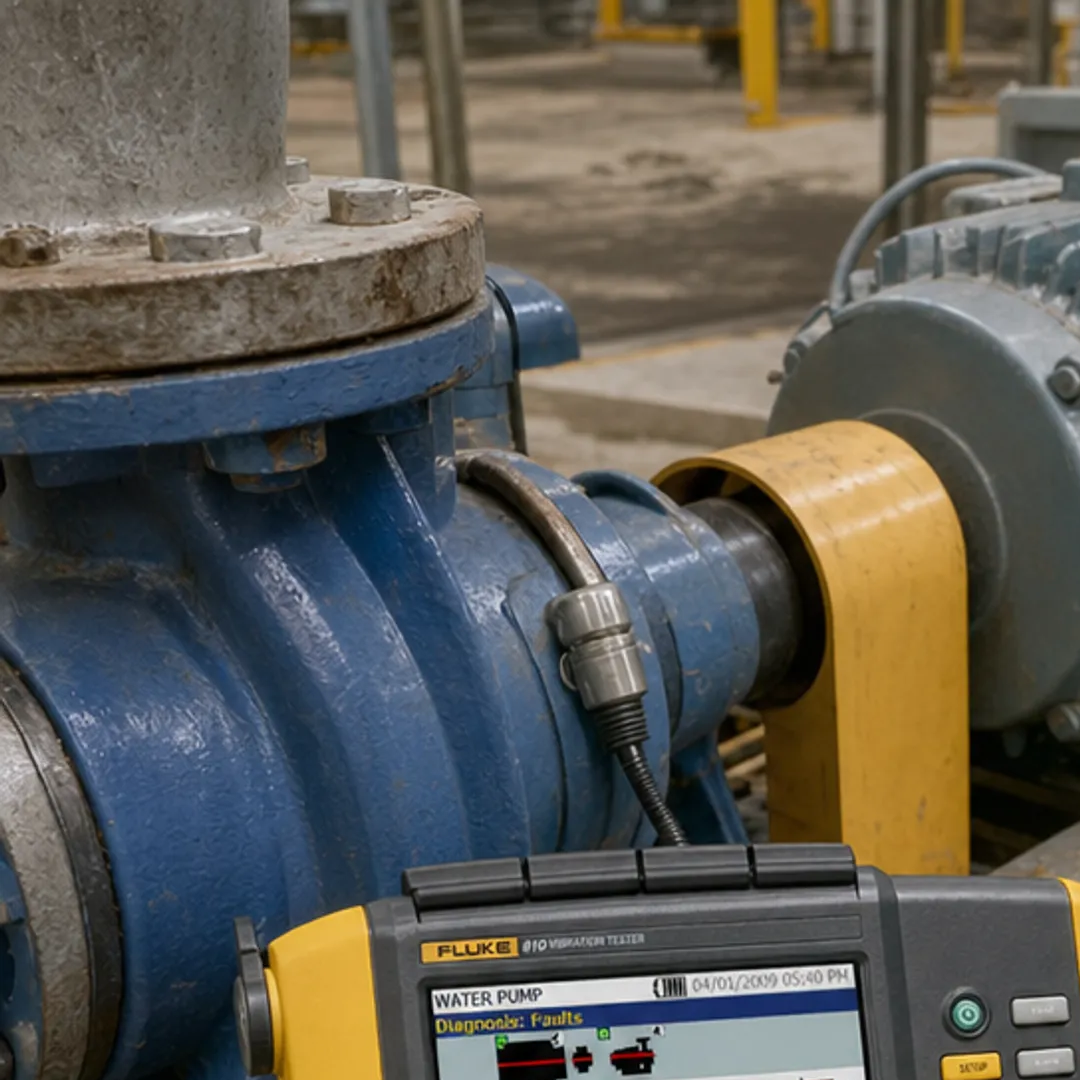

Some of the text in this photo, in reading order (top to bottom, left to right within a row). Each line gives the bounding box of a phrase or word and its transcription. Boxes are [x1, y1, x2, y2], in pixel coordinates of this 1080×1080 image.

[437, 941, 511, 957] FLUKE
[607, 933, 645, 946] TESTER
[782, 971, 823, 987] 05:40
[828, 968, 849, 983] PM
[435, 988, 543, 1008] WATER PUMP
[435, 1010, 583, 1036] Diagnosis: Faults
